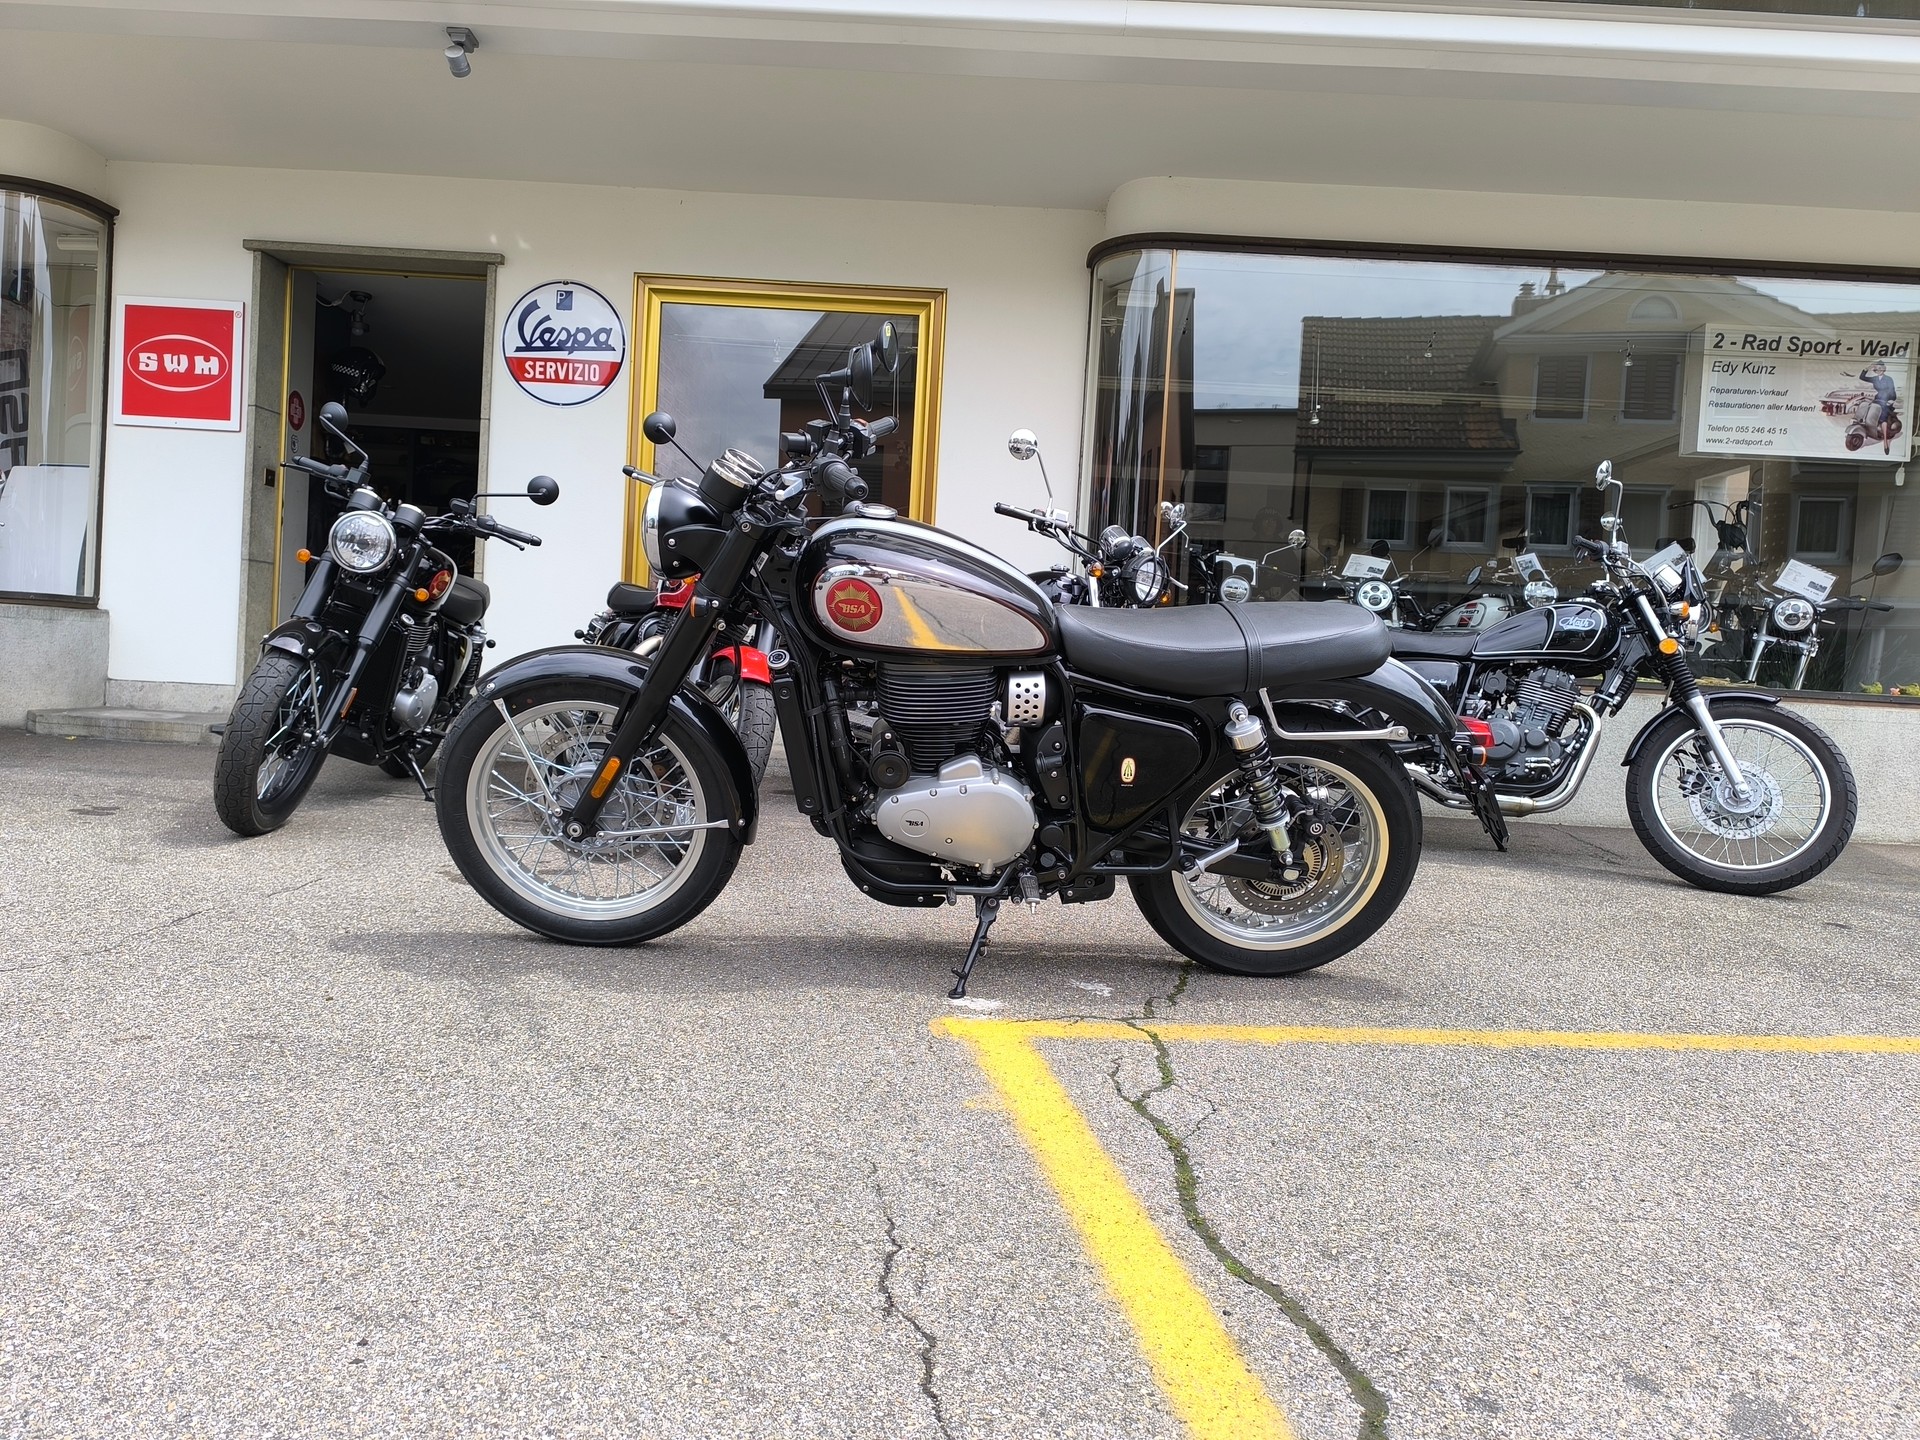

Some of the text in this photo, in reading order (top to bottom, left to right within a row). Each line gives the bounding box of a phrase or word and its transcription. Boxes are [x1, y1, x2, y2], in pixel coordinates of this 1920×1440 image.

[513, 299, 617, 356] Vespa
[1713, 332, 1725, 349] 2
[1741, 333, 1782, 352] Rad
[1787, 336, 1842, 357] Sport
[1860, 339, 1910, 358] Wald
[138, 352, 220, 376] SWM
[1711, 360, 1777, 376] Edy Kunz
[524, 360, 600, 382] SERVIZIO
[1709, 385, 1789, 397] Reparaturen-Verkauf
[1708, 400, 1817, 413] Restaurationen aller Marken!
[1707, 424, 1788, 435] Telefon 055 246 45 15
[1705, 437, 1774, 447] www.2-radsport.ch
[838, 602, 866, 614] BSA
[1565, 616, 1591, 628] Mash
[905, 819, 924, 827] BSA
